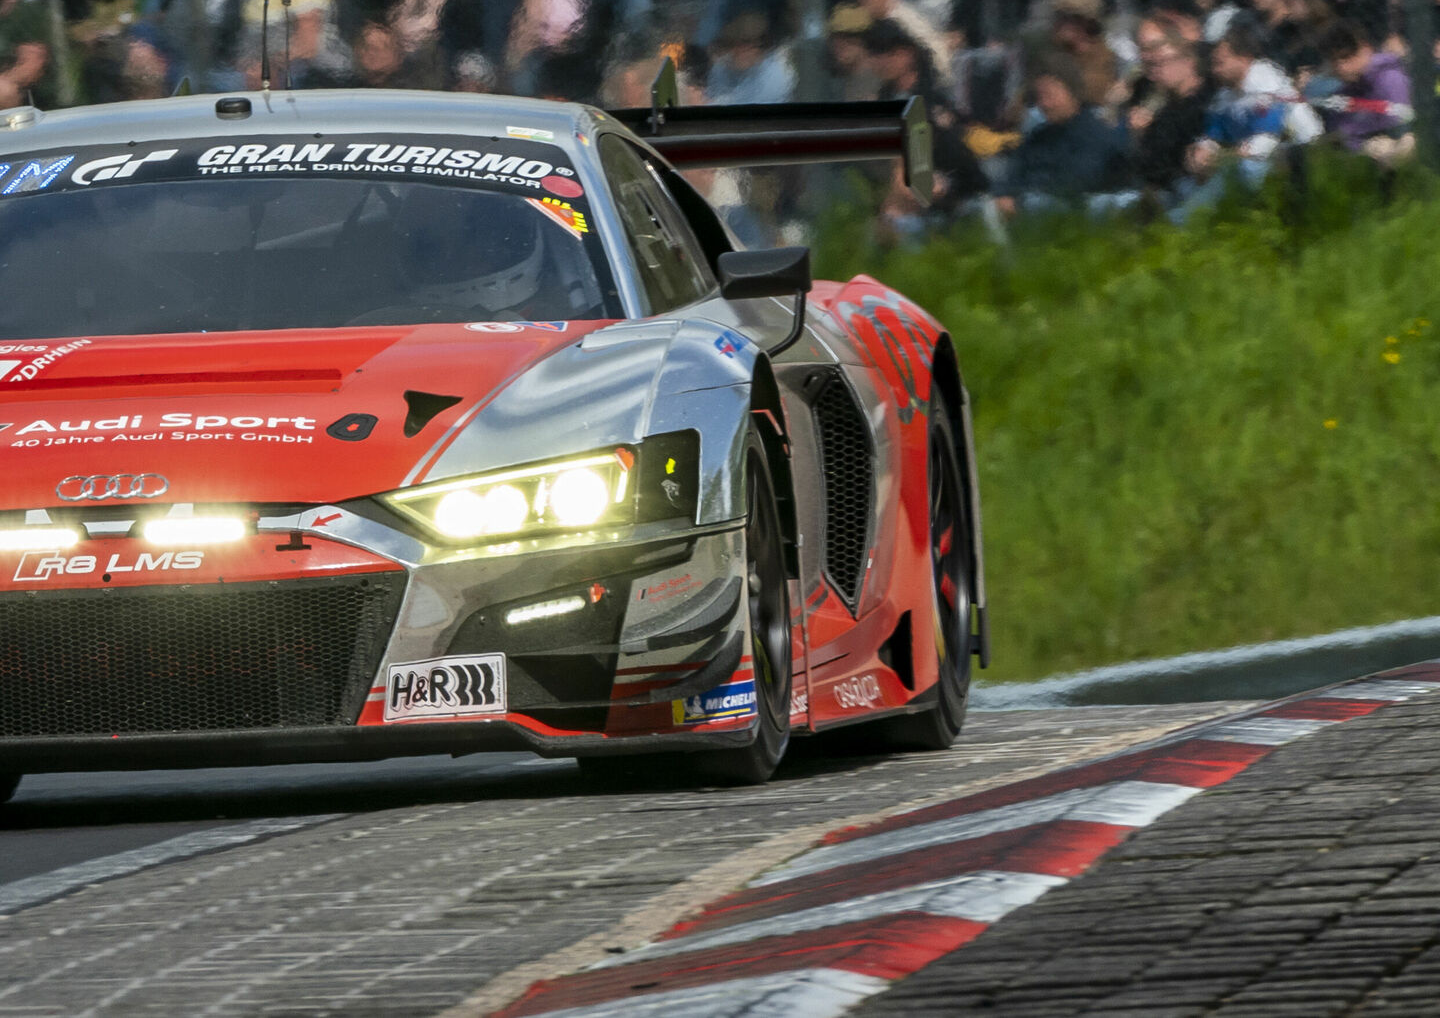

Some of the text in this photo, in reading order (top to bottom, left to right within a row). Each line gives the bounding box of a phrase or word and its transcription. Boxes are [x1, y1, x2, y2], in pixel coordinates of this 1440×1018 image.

[196, 143, 332, 167] GRAN
[197, 163, 542, 190] THE REAL DRIVING SIMULATOR
[14, 412, 317, 436] Audi Sport
[9, 431, 314, 448] 40 Jahre Audi Sport GmbH
[31, 550, 205, 576] R8 LMS
[390, 666, 458, 713] H&R
